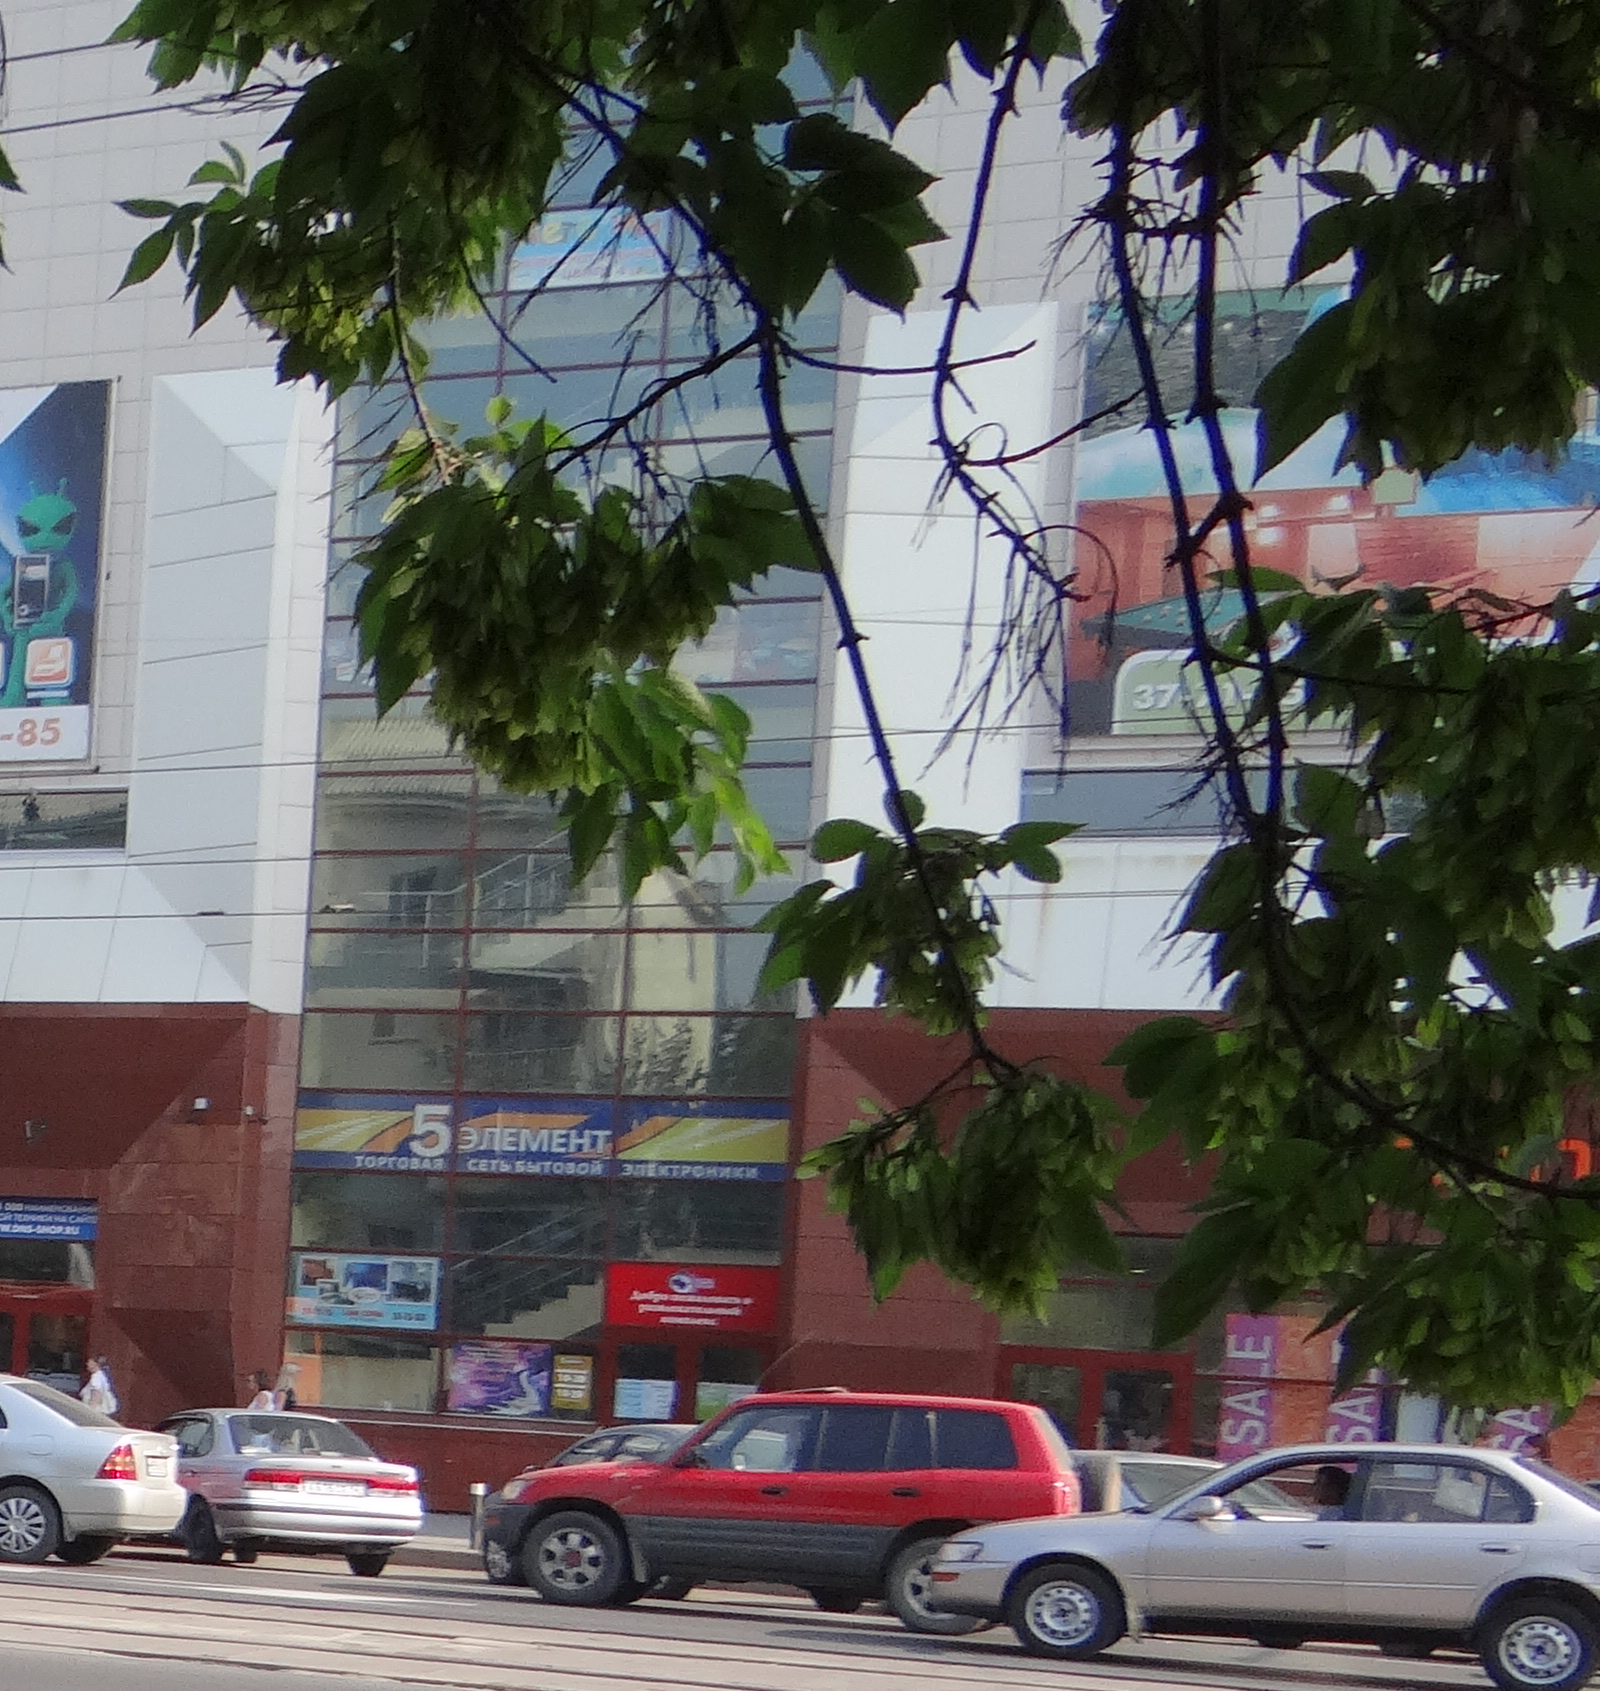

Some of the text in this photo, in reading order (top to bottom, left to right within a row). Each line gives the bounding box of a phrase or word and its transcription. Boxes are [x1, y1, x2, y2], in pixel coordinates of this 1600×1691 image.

[409, 1103, 614, 1159] 5 ЭЛЕМЕНТ
[355, 1156, 759, 1180] ТОРГОВАЯ СЕТЬ БЫТОВОЙ ЭЛЕКТРОНИКИ
[1220, 1334, 1273, 1446] SALE
